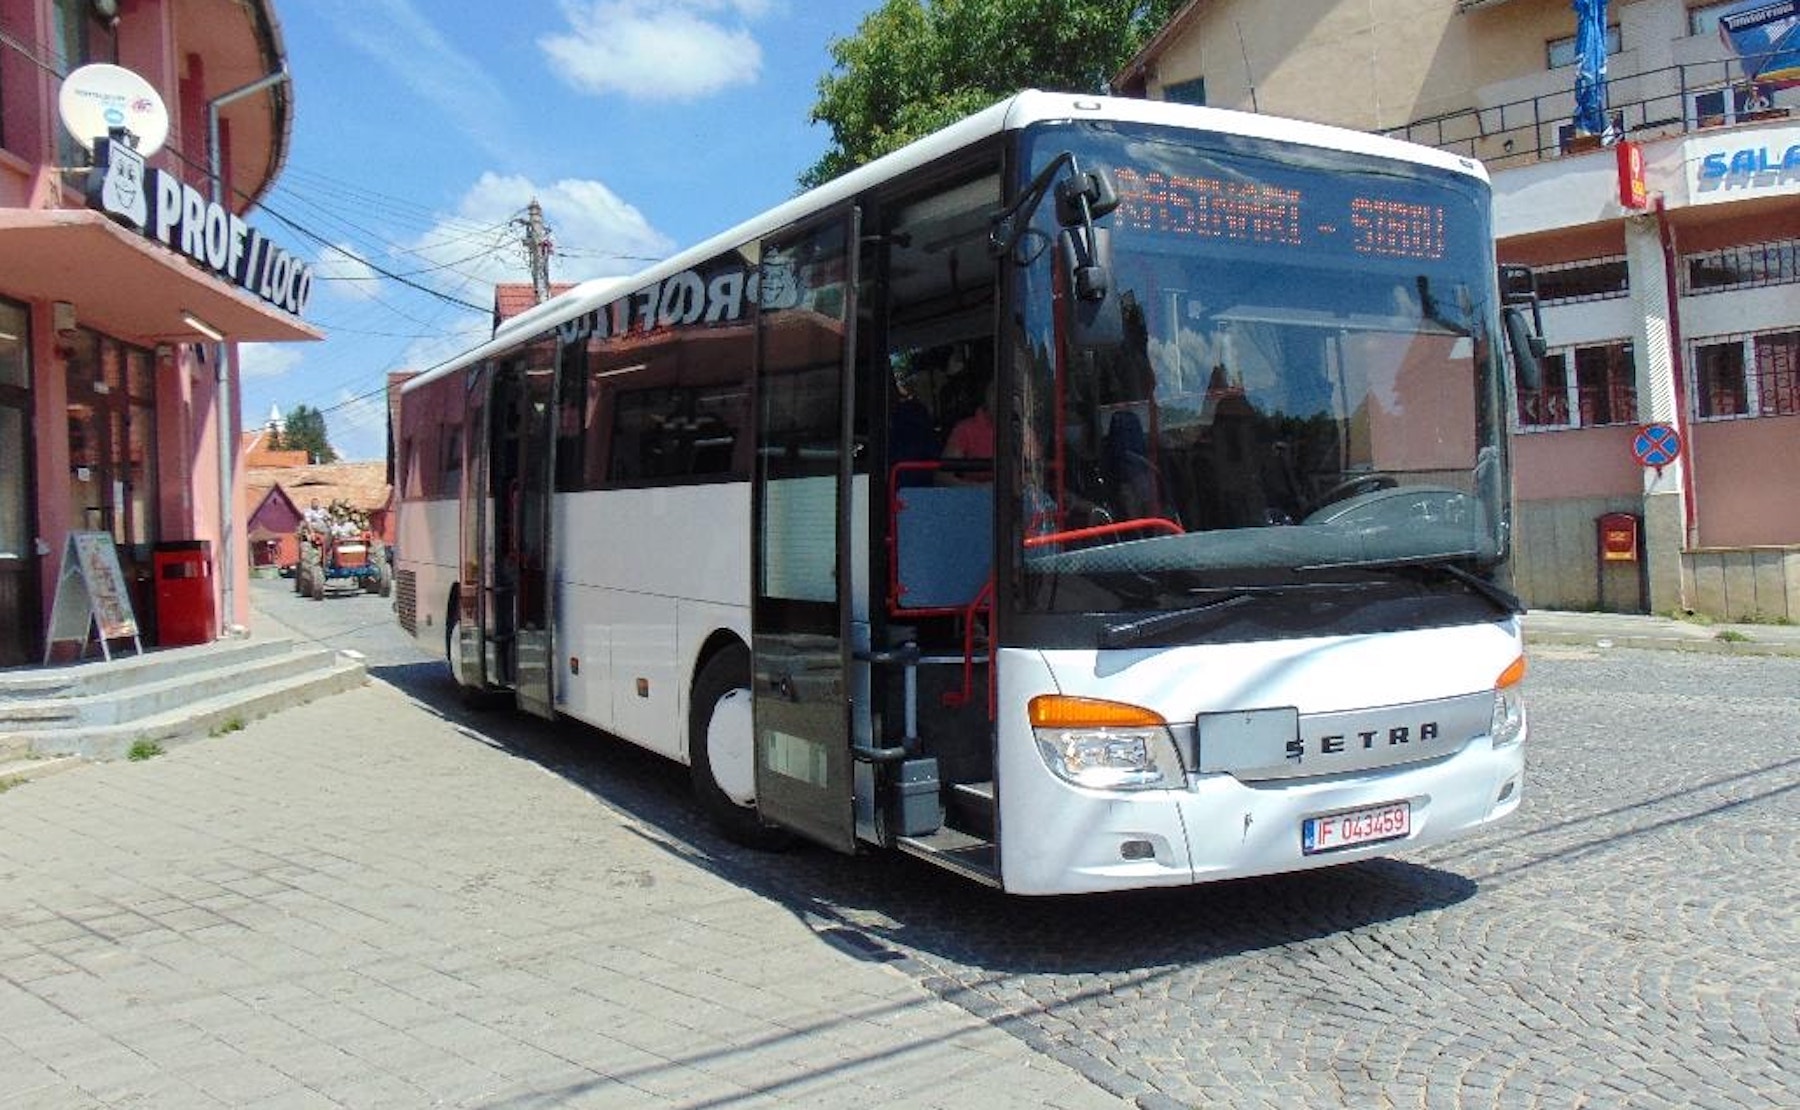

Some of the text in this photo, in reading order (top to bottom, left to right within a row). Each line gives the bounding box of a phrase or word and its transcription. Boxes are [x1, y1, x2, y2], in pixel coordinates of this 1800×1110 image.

[1351, 198, 1445, 258] SIBIU
[1286, 721, 1438, 760] SETRA
[1318, 818, 1336, 846] IF
[1341, 808, 1405, 841] 043459
